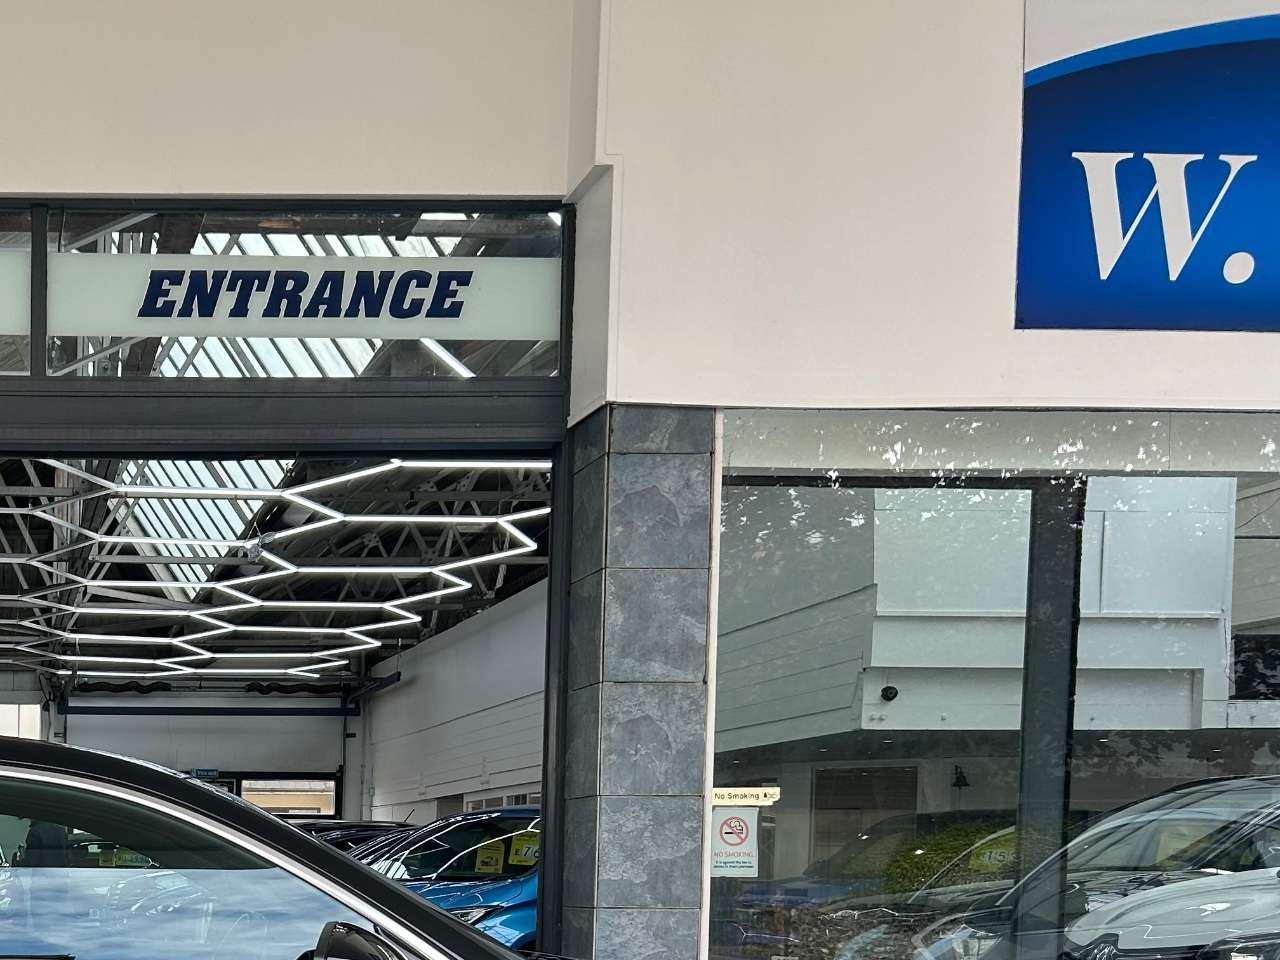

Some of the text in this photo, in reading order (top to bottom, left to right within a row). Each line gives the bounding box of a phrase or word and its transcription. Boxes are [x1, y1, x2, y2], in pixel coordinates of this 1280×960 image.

[1071, 151, 1259, 284] W.
[137, 269, 474, 319] ENTRANCE
[714, 792, 760, 801] No Smoking
